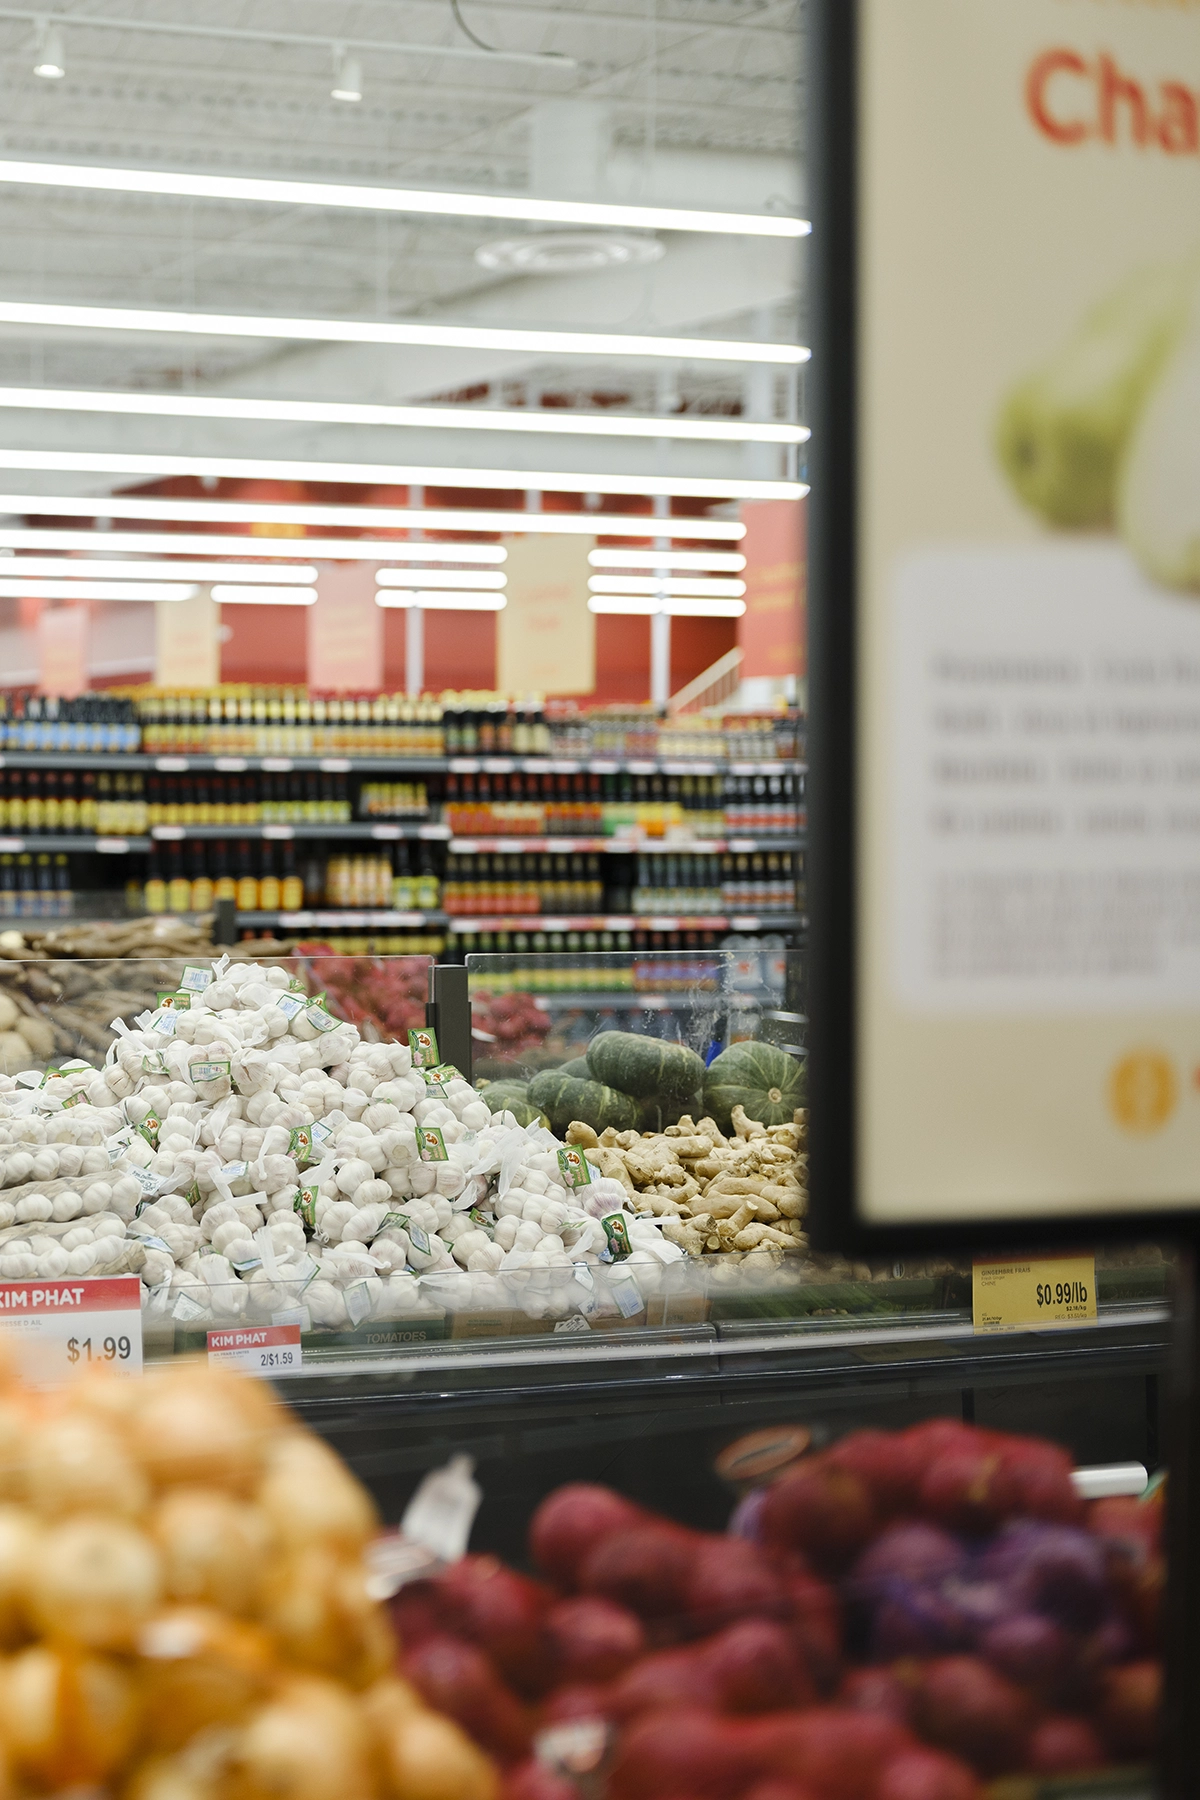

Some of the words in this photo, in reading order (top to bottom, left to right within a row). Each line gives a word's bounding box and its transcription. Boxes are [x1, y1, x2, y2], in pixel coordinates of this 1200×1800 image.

[32, 1288, 84, 1306] PHAT
[1036, 1282, 1088, 1308] $0.99/lb
[211, 1335, 234, 1347] KIM
[236, 1332, 267, 1345] PHAT
[365, 1331, 427, 1345] TOMATOES
[67, 1335, 131, 1364] $1.99
[260, 1352, 293, 1367] 2/$1.59
